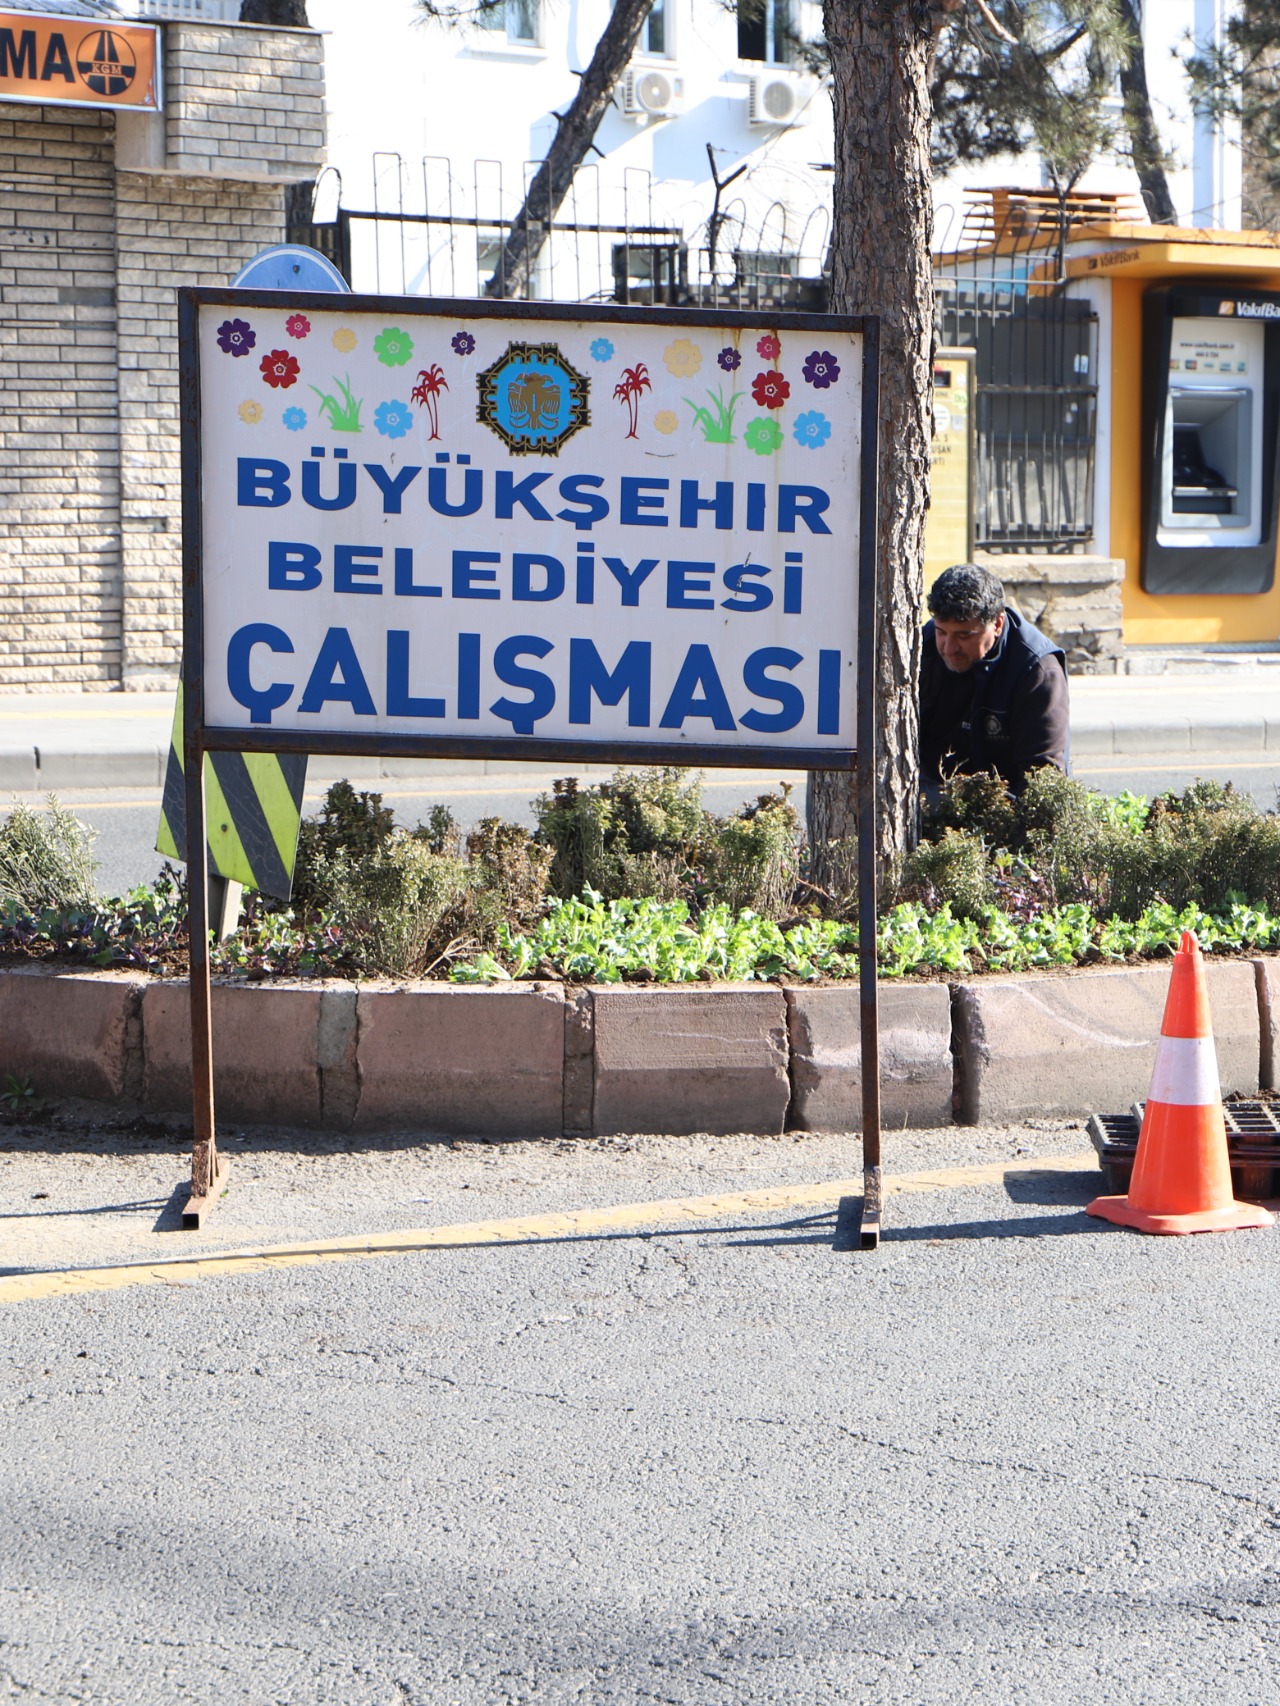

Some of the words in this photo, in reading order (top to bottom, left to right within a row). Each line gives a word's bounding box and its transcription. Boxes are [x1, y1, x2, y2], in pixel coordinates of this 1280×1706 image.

[91, 62, 122, 75] KGM
[237, 446, 833, 535] BÜYÜKŞEHIR
[268, 541, 803, 615] BELEDİYESİ
[227, 622, 841, 736] ÇALIŞMASI
